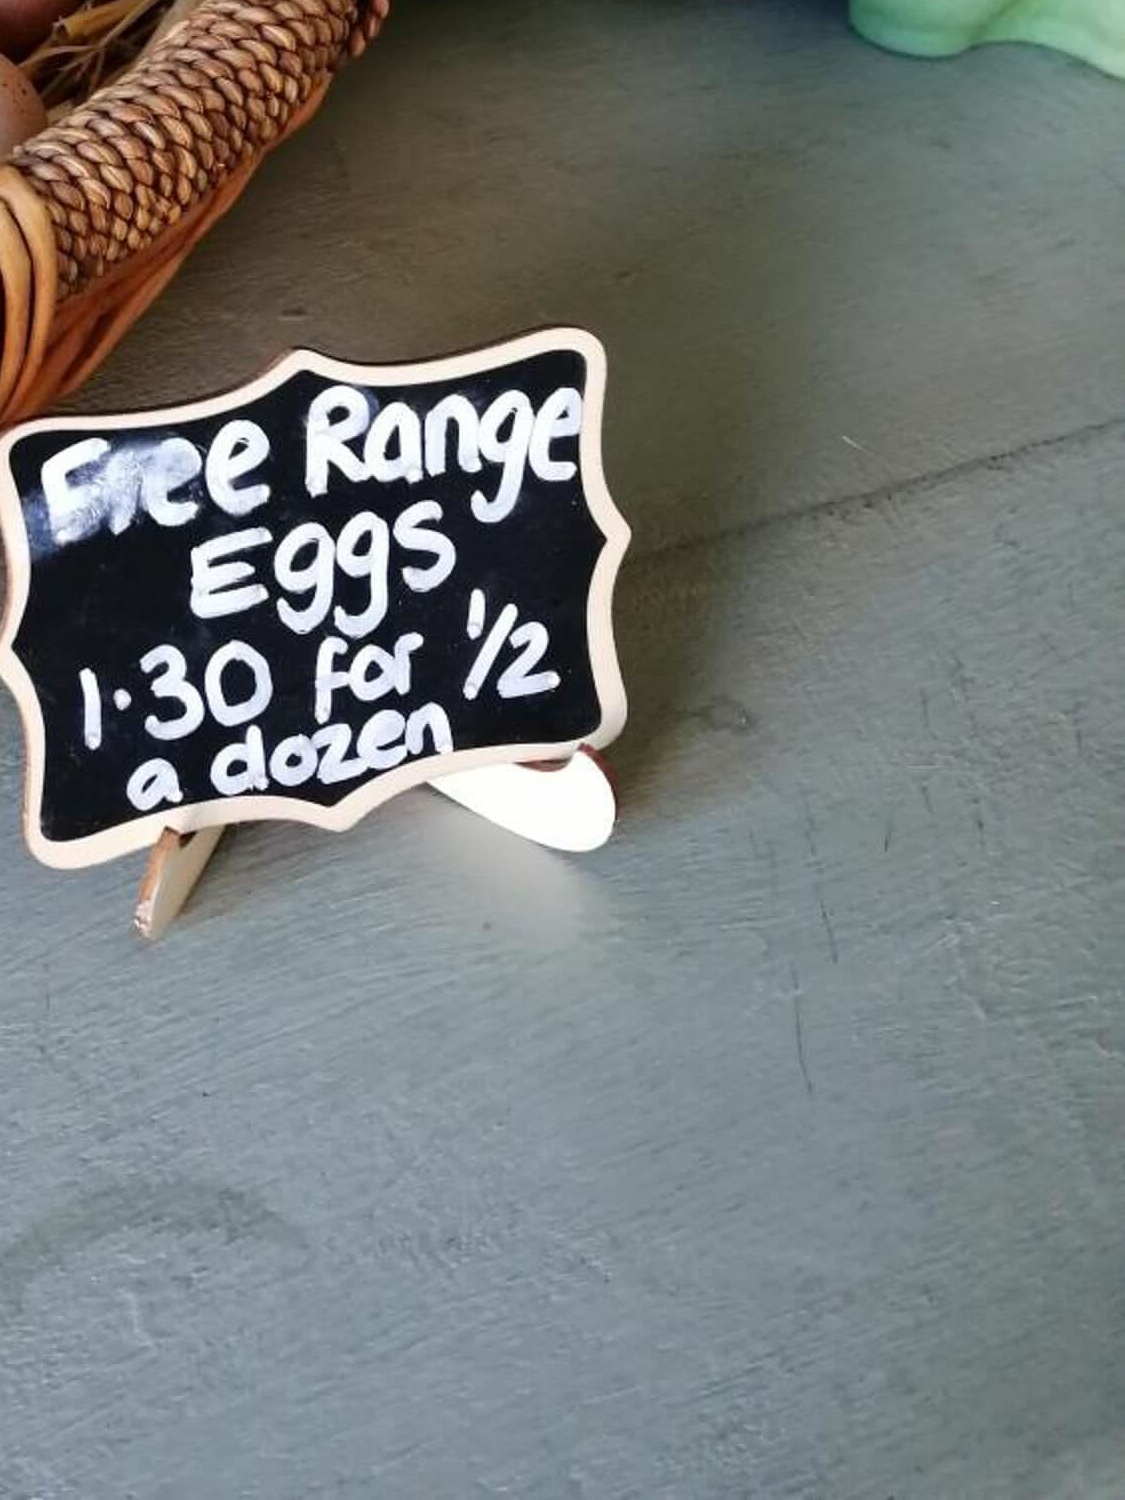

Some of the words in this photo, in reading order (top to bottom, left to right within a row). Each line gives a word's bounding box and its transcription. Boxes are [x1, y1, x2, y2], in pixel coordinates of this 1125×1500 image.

[41, 420, 271, 545] Free
[305, 385, 582, 523] Range
[190, 500, 456, 638] Eggs
[314, 633, 424, 724] for
[126, 758, 184, 811] a
[211, 702, 454, 796] dozen
